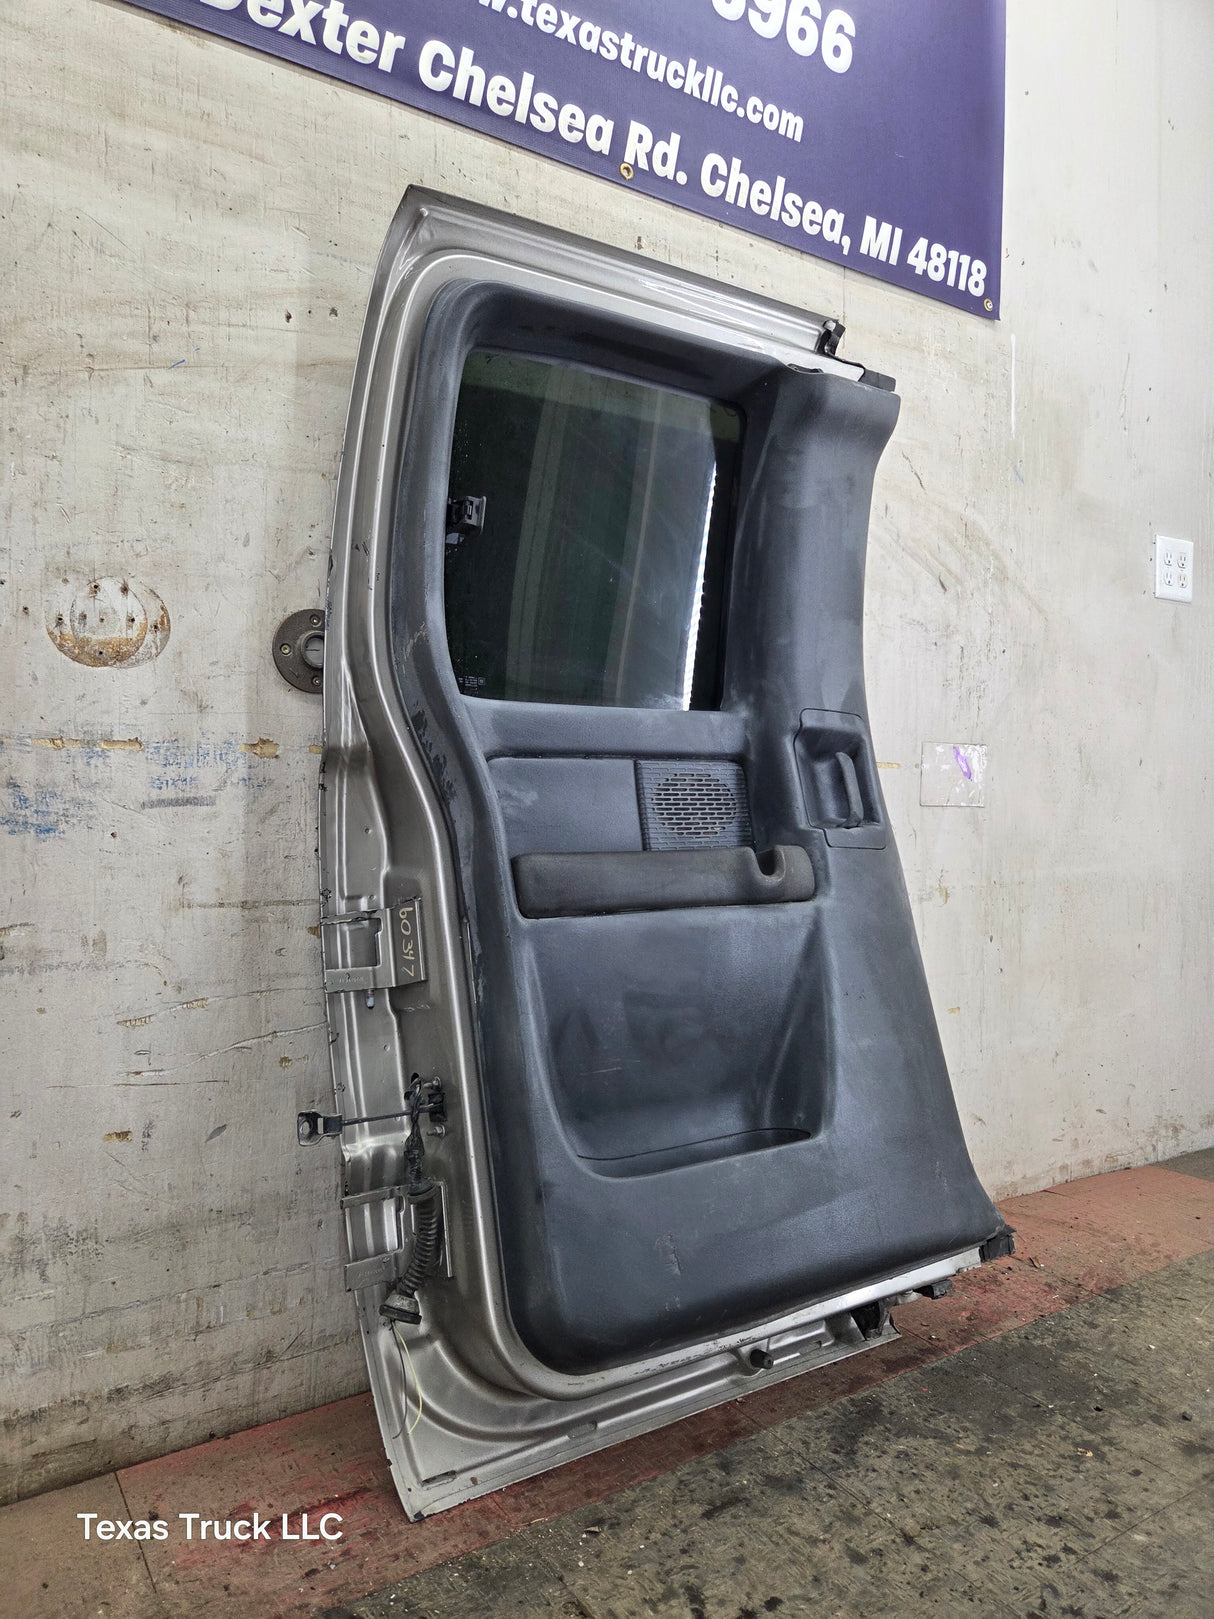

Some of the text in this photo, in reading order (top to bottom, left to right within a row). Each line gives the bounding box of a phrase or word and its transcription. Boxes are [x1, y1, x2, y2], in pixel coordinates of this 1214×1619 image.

[201, 0, 987, 297] exter Chelsea Rd. Chelsea, MI 48118
